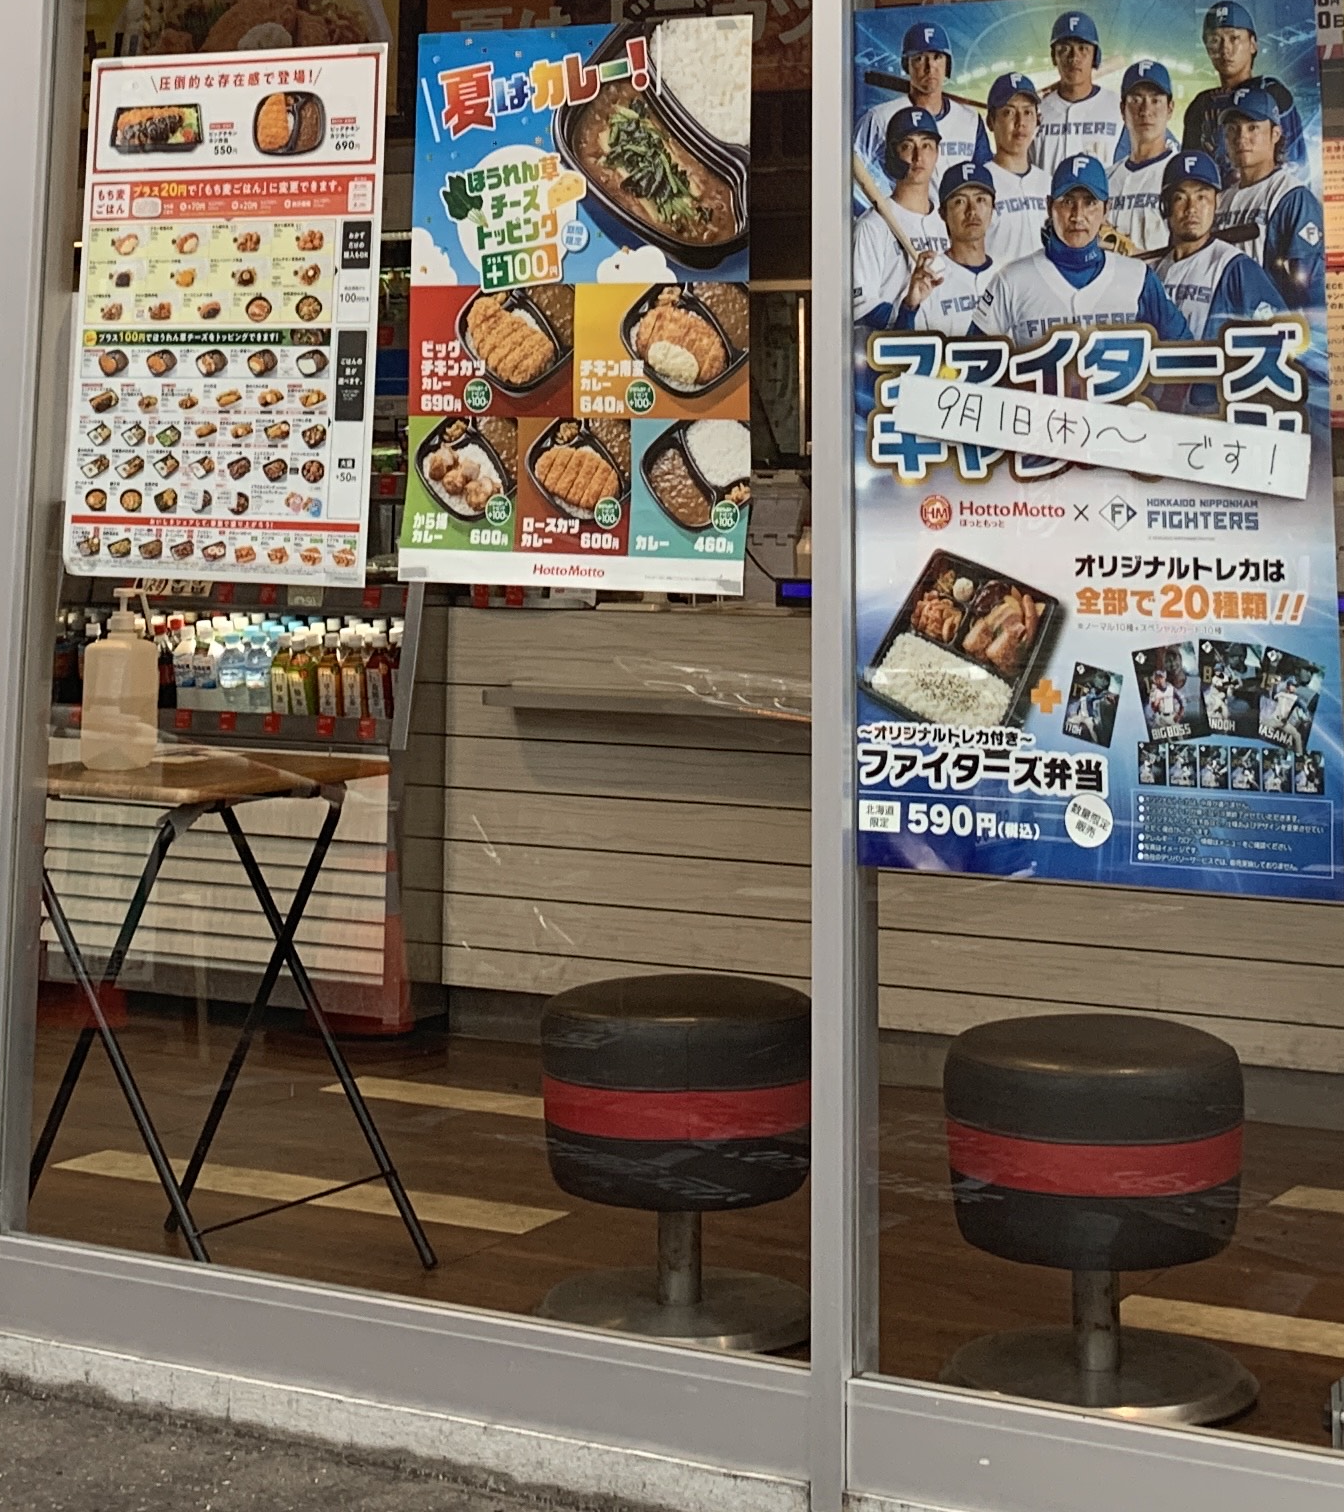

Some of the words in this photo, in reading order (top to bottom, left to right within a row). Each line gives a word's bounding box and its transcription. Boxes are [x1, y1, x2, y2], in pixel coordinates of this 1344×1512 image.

[159, 69, 313, 91] 圧倒的な存在感で登場!
[439, 37, 649, 139] 夏はカレー!
[467, 156, 560, 194] ほうれん草
[491, 185, 541, 220] チーズ
[996, 196, 1046, 216] FIGHTE
[476, 209, 559, 251] トッピング
[421, 341, 461, 358] ビッグ
[421, 359, 486, 376] チキンカツ
[421, 376, 452, 390] カレー
[580, 377, 612, 391] カレー
[1147, 498, 1197, 509] HOKKAIDO
[1200, 498, 1259, 509] NIPPONHAM
[522, 517, 580, 534] ロースカツ
[1147, 511, 1260, 531] FIGHTERS
[412, 529, 443, 544] カレー
[521, 533, 553, 548] カレー
[635, 535, 670, 551] カレー
[1074, 554, 1286, 583] オリジナルトレカは
[861, 749, 1104, 793] ファイターズ弁当
[866, 804, 895, 817] 北海道
[869, 817, 890, 829] 限定
